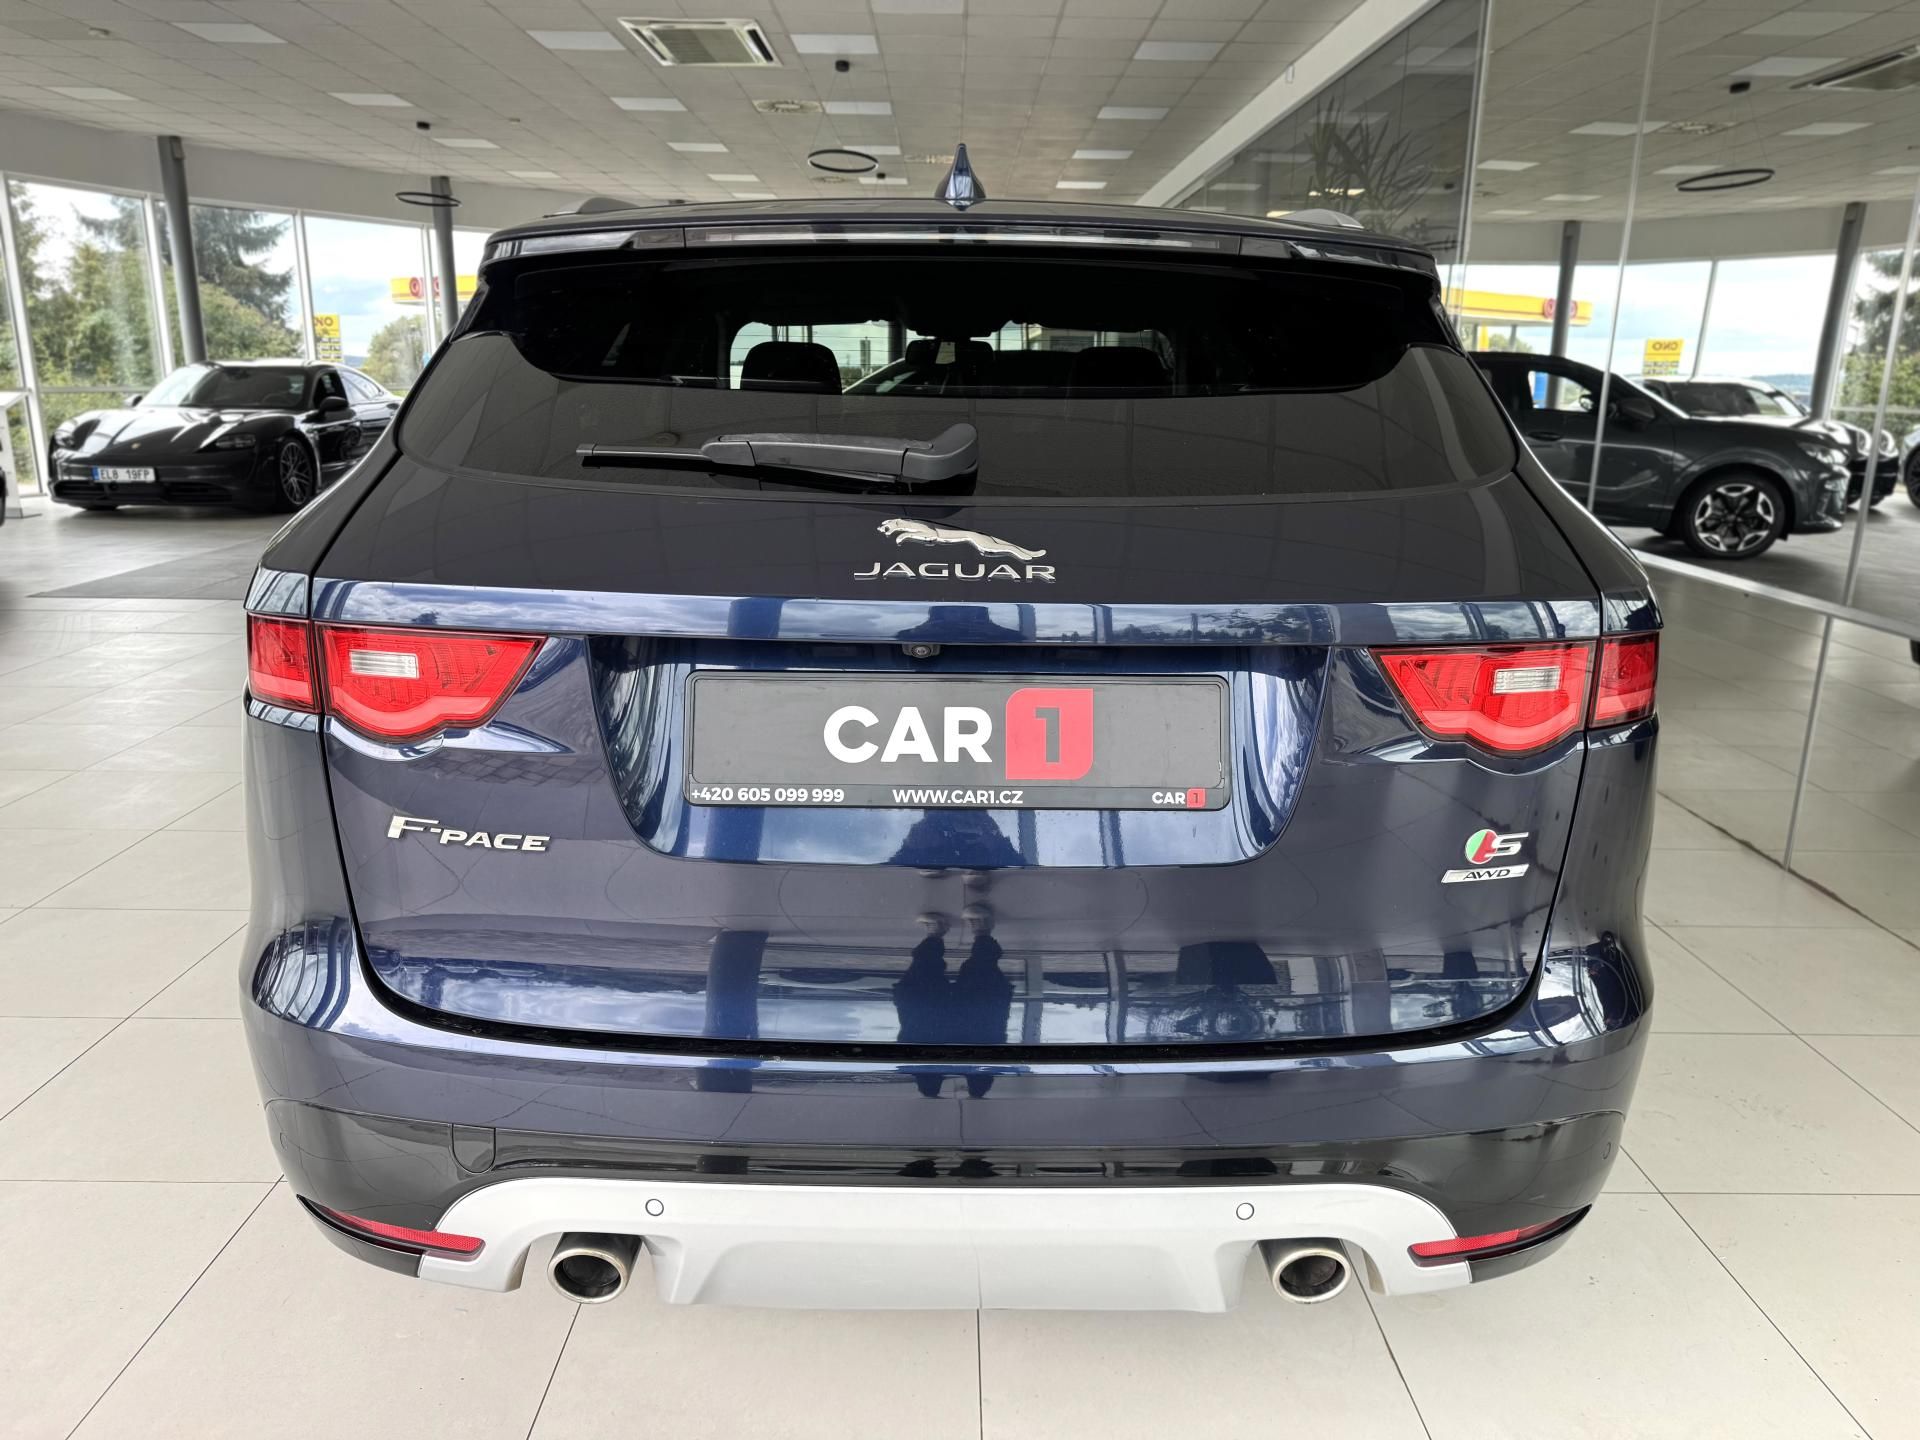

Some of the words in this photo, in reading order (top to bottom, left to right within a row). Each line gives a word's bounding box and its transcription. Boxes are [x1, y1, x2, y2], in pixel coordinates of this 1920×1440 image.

[854, 562, 1056, 582] JAGUAR
[691, 787, 734, 801] +420
[737, 787, 771, 802] 605
[774, 788, 809, 802] 099
[812, 788, 845, 803] 999
[892, 789, 1024, 804] WWW.CAR1.CZ
[387, 815, 551, 851] F-PACE
[1463, 868, 1511, 881] AWD
